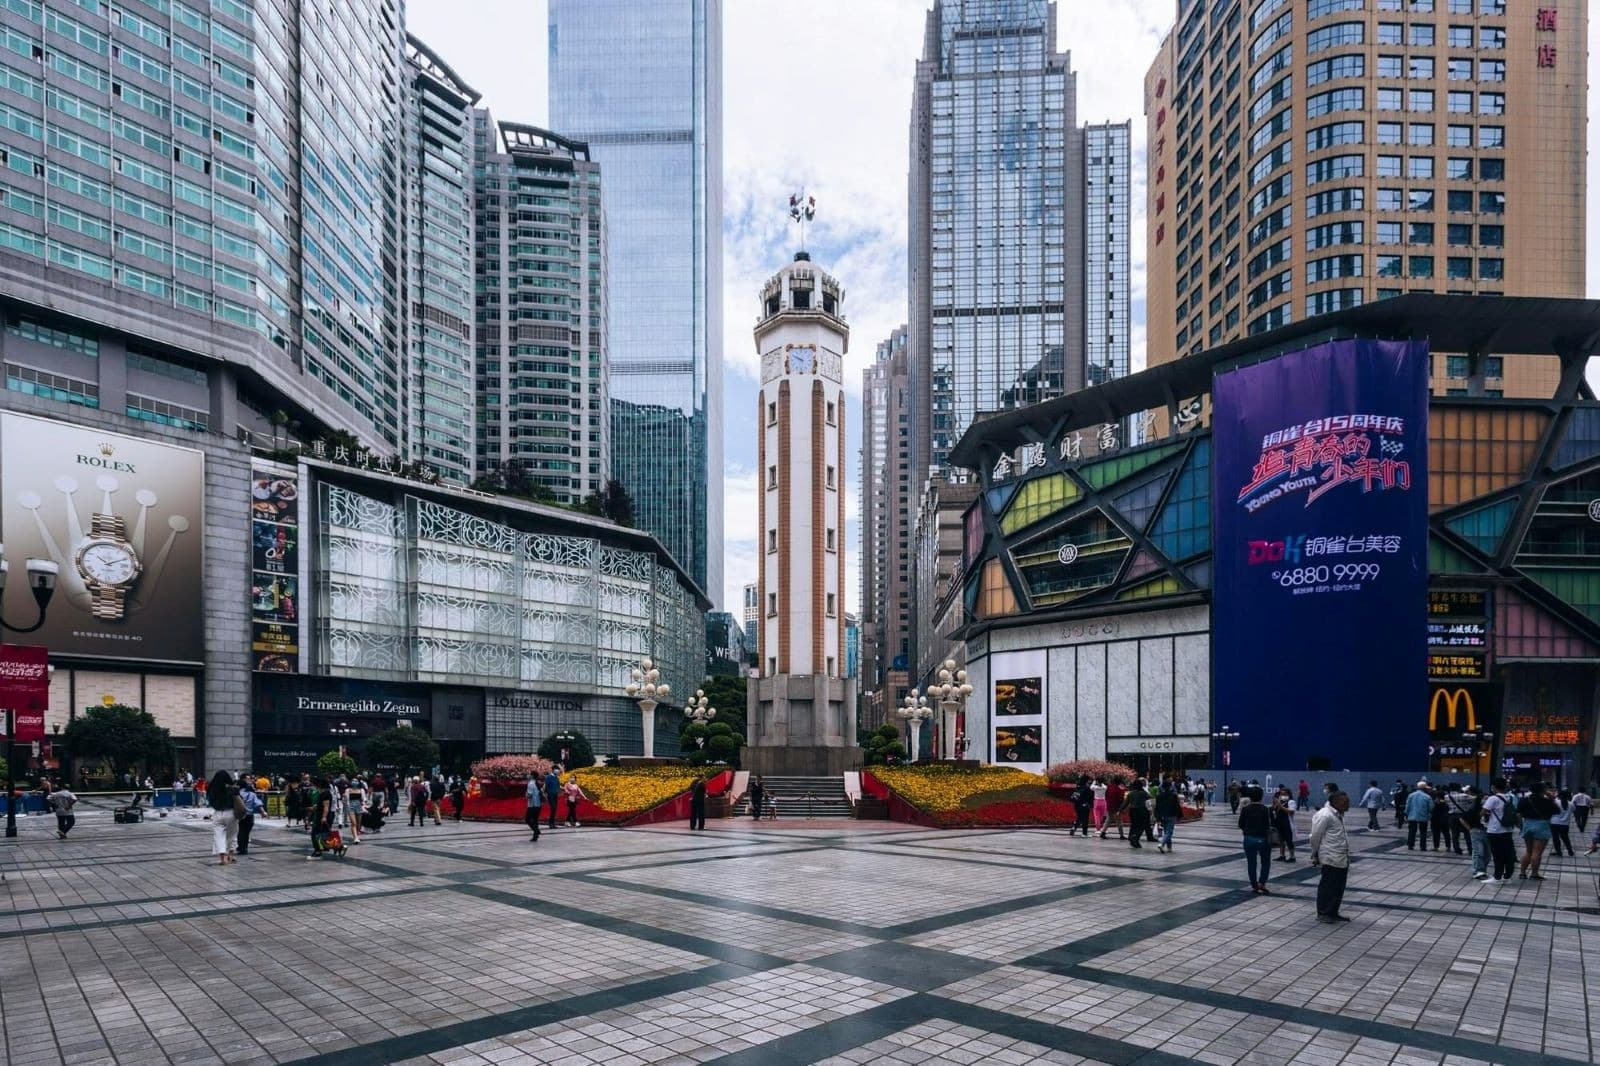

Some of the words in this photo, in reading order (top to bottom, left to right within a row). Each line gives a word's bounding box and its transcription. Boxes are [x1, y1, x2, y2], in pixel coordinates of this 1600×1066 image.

[1536, 8, 1558, 68] 酒店
[1262, 413, 1405, 449] 铜雀台15周年庆
[76, 454, 137, 474] ROLEX
[1238, 432, 1372, 502] 追青春的
[1304, 455, 1411, 508] 少年们
[1305, 535, 1402, 557] 铜雀台美容
[1280, 565, 1329, 587] 6880
[1333, 563, 1380, 581] 9999
[297, 696, 380, 714] Ermenegildo
[383, 701, 420, 715] Zegna
[494, 695, 531, 708] LOUIS
[533, 698, 584, 711] VUITTON
